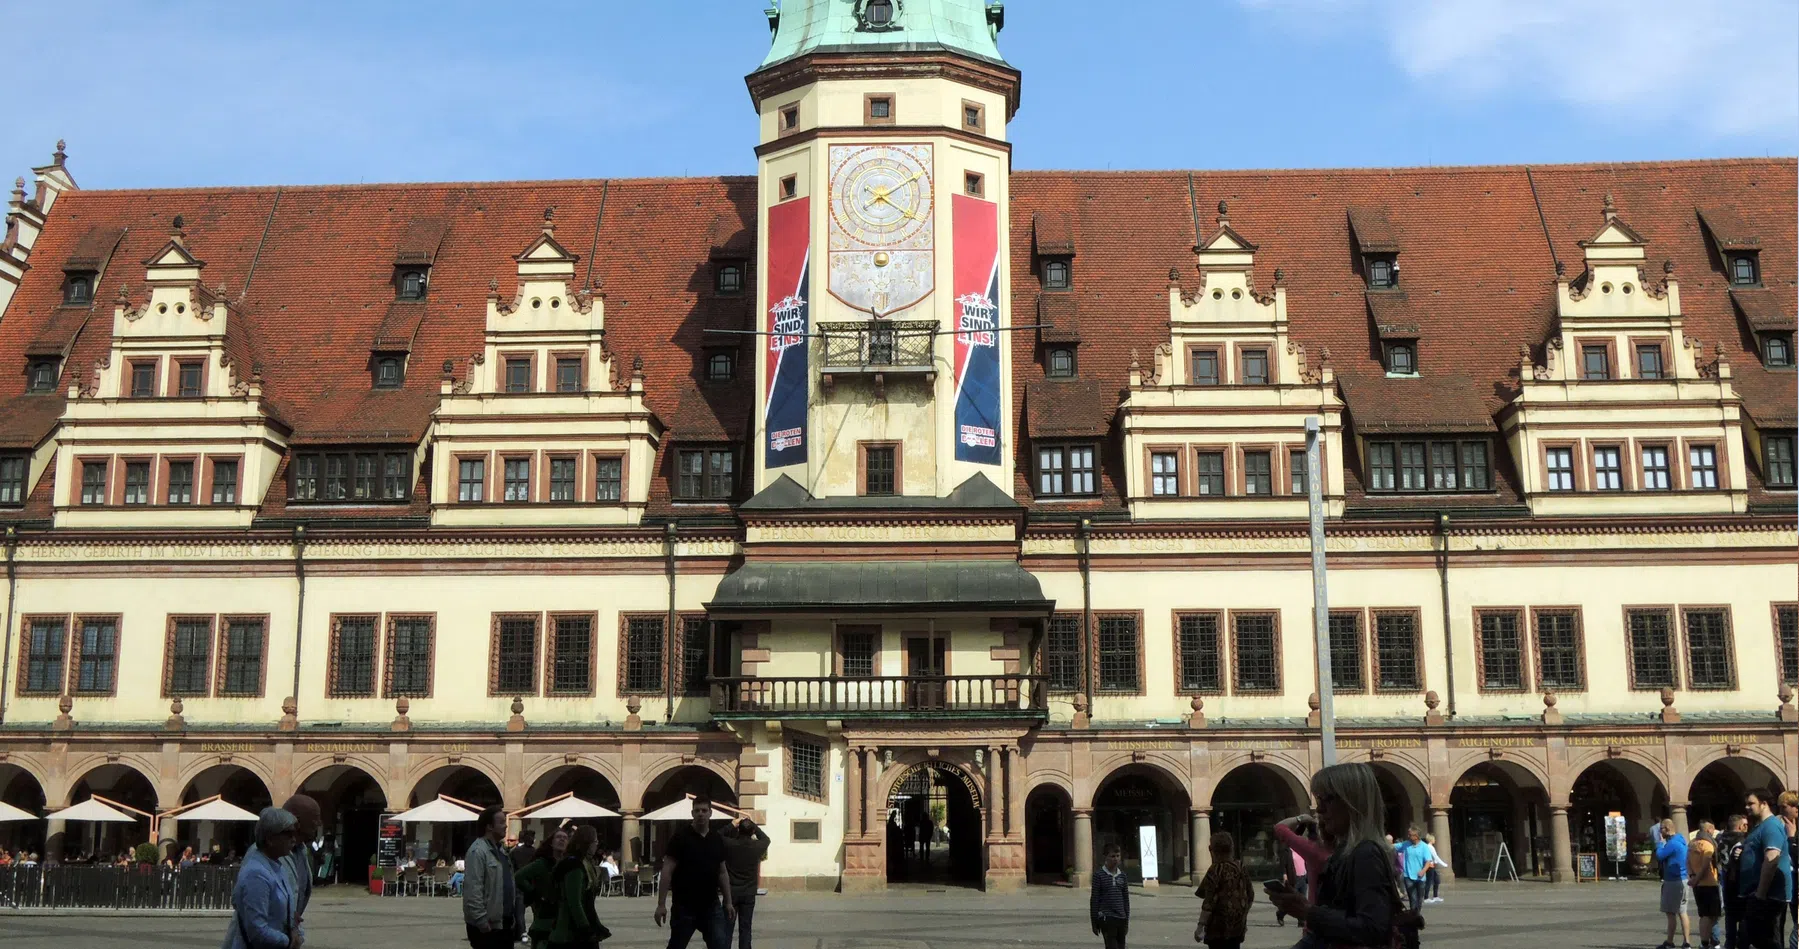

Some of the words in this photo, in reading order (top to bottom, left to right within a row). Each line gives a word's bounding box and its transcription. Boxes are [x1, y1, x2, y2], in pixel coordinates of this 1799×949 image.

[774, 320, 801, 334] SIND
[961, 317, 992, 330] SIND
[782, 429, 801, 437] ROTEN
[973, 428, 995, 436] ROTEN
[759, 528, 814, 540] HERRN
[30, 547, 78, 558] HERRN
[83, 546, 143, 558] GEBURTH
[149, 547, 165, 558] IM
[260, 546, 282, 557] BEY
[377, 545, 402, 557] DES
[1107, 740, 1173, 750] MEISSENER
[1224, 739, 1293, 749] PORZELLAN
[1370, 738, 1422, 749] TROPFEN
[1459, 737, 1534, 748] AUGENOPTIK
[1568, 736, 1589, 746] TEE
[1591, 736, 1601, 745] &
[201, 742, 256, 752] BRASSERIE
[307, 742, 376, 752] RESTAURANT
[1114, 788, 1153, 797] MEISSEN
